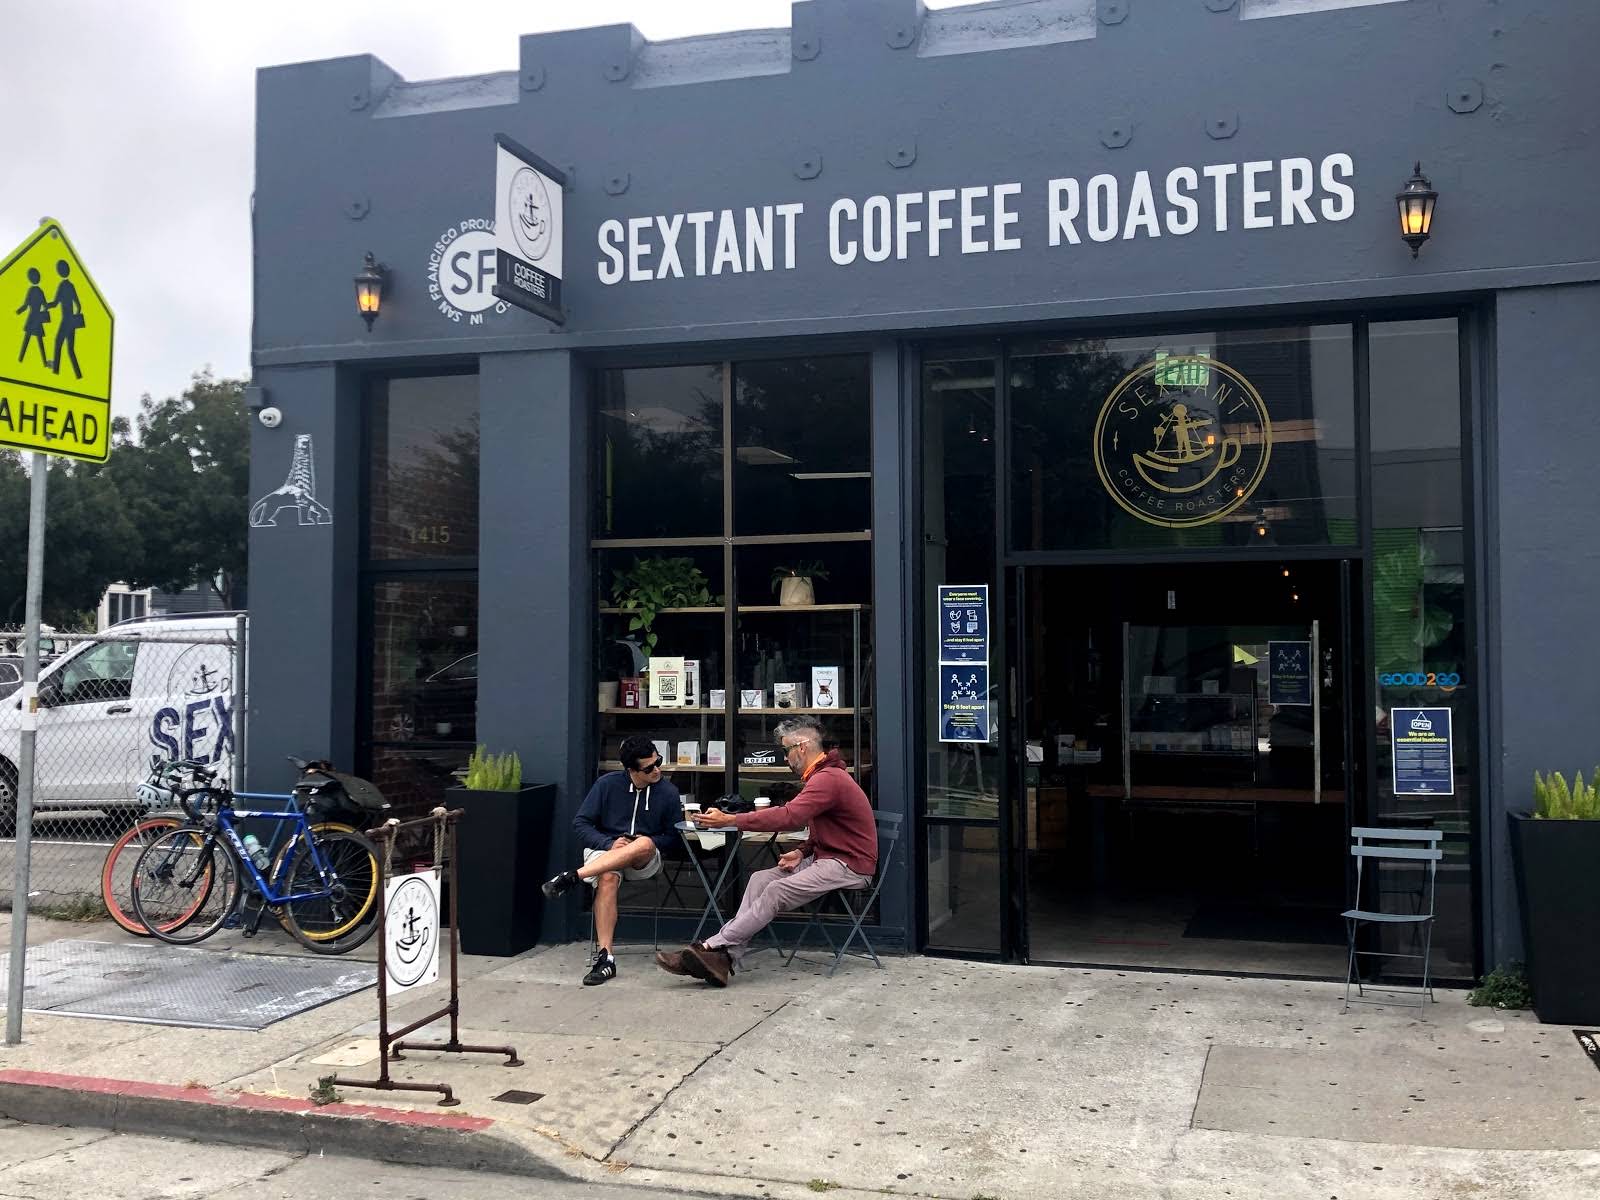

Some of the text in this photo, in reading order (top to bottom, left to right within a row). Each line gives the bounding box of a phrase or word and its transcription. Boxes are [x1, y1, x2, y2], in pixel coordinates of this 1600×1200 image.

[598, 153, 1355, 286] SEXTANT COFFEE ROASTERS
[427, 228, 484, 325] IN SAN FRANCISCO
[451, 249, 496, 295] SF
[513, 275, 546, 299] ROASTERS
[514, 262, 545, 288] COFFEE
[0, 397, 98, 445] AHEAD
[1119, 466, 1246, 511] COFFEE ROASTERS
[1380, 672, 1460, 686] GOOD2GO
